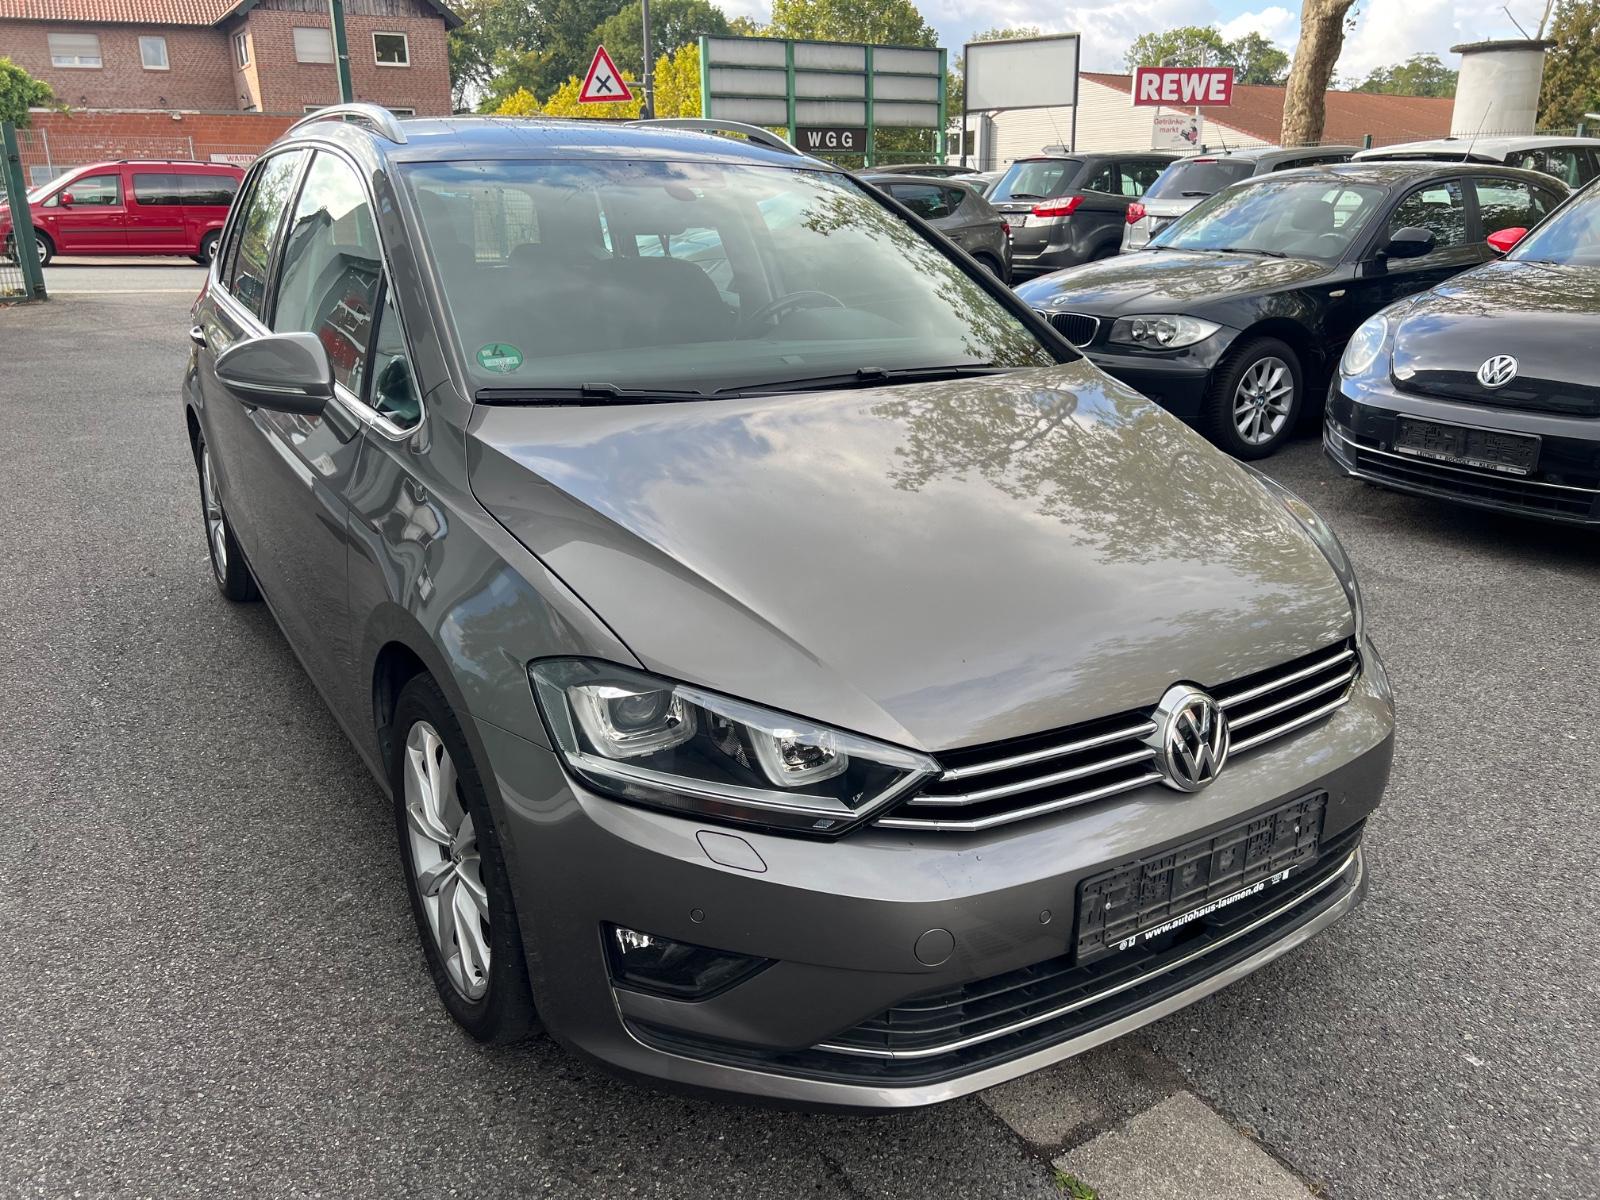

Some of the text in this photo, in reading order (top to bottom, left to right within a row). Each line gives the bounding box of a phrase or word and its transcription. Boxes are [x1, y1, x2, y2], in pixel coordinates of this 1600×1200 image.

[1140, 73, 1227, 103] REWE
[1154, 118, 1186, 126] Getränke-
[1159, 126, 1179, 134] markt
[1144, 881, 1265, 940] www.autohaus-laumen.de
